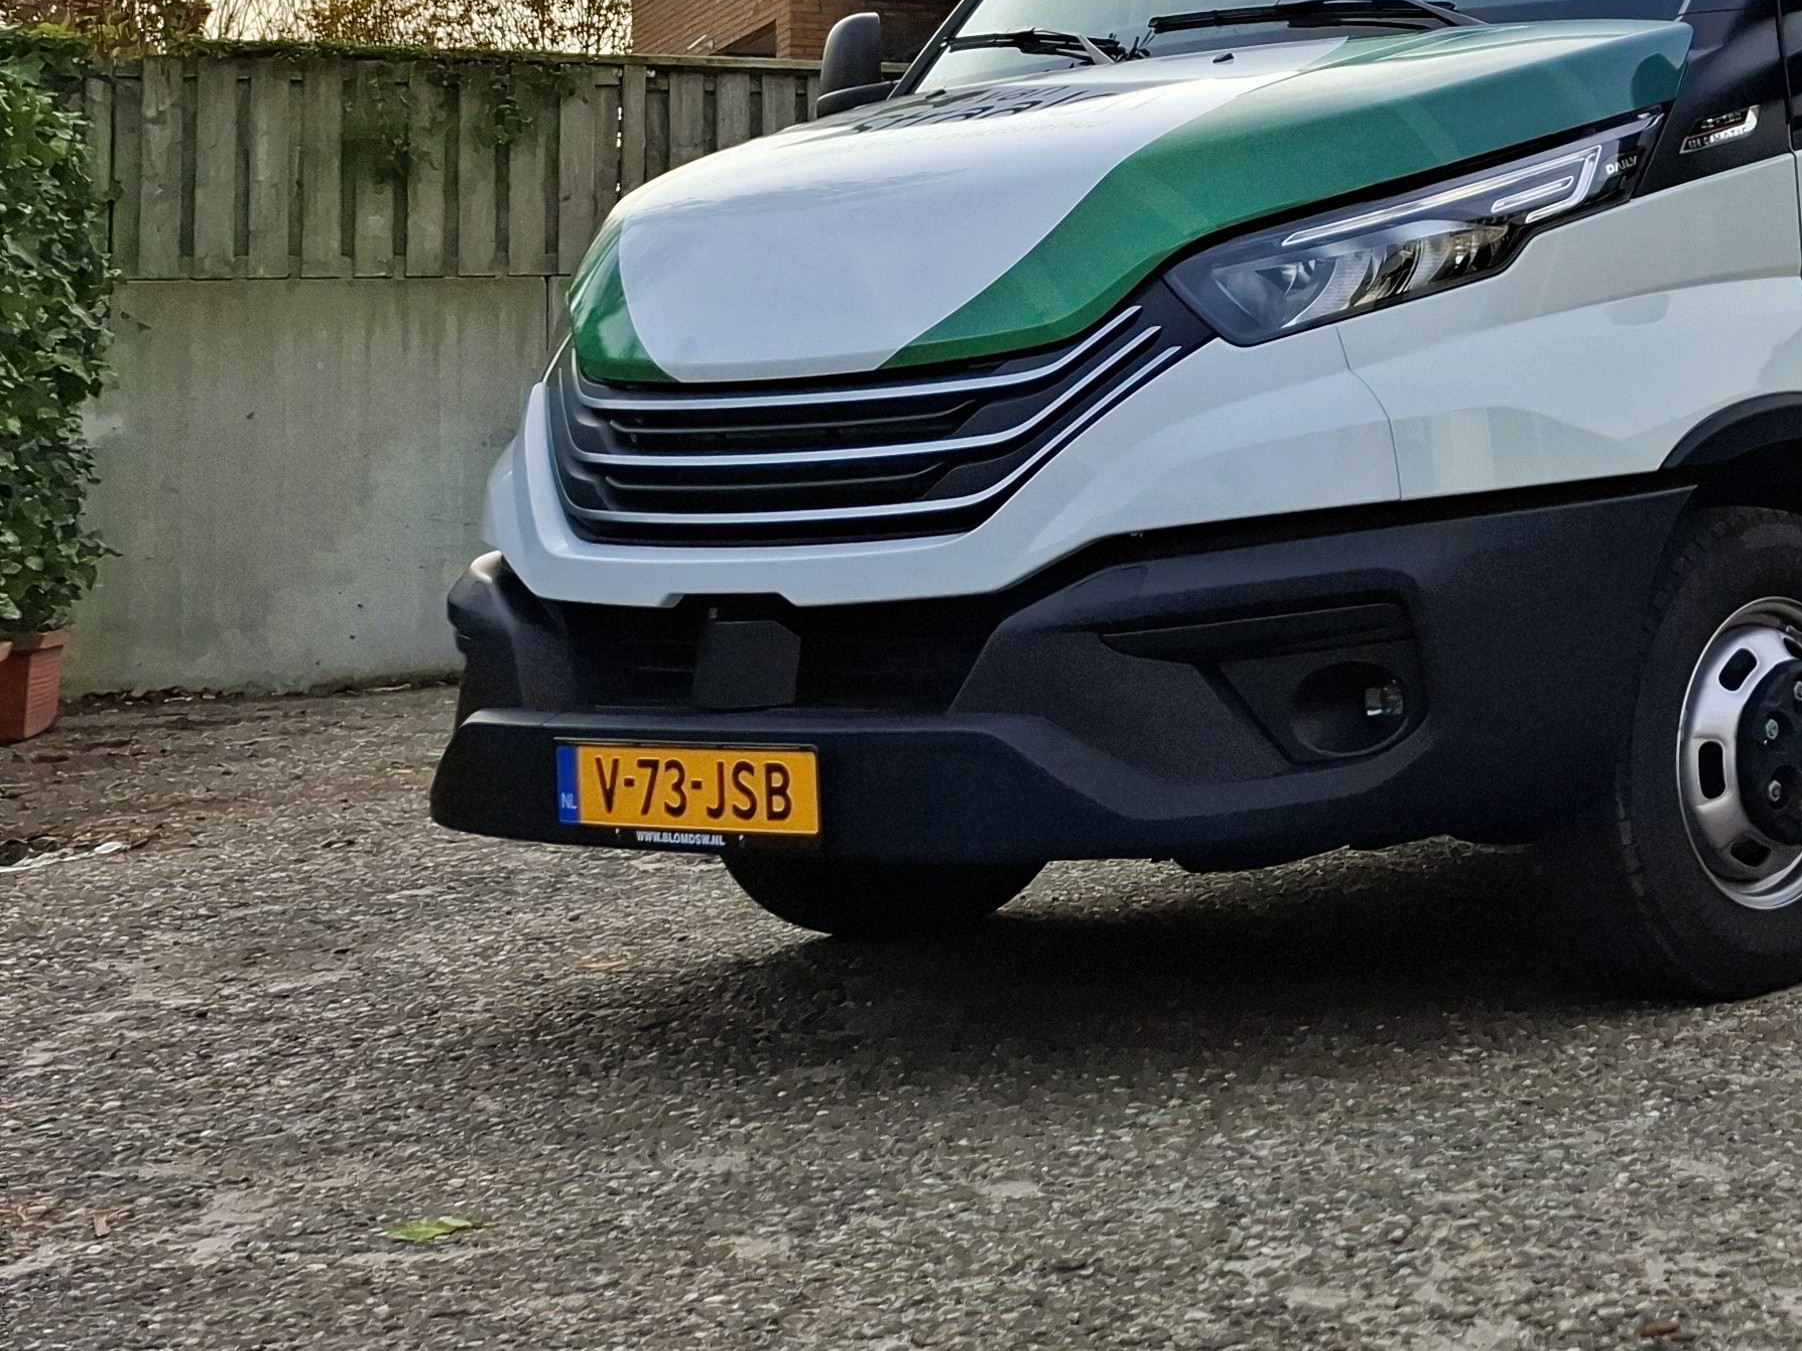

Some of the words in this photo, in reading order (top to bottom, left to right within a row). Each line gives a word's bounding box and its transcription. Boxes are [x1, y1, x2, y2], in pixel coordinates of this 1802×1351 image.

[1605, 155, 1638, 175] DAILY
[594, 755, 793, 821] V-73-JSB
[561, 793, 578, 810] NL
